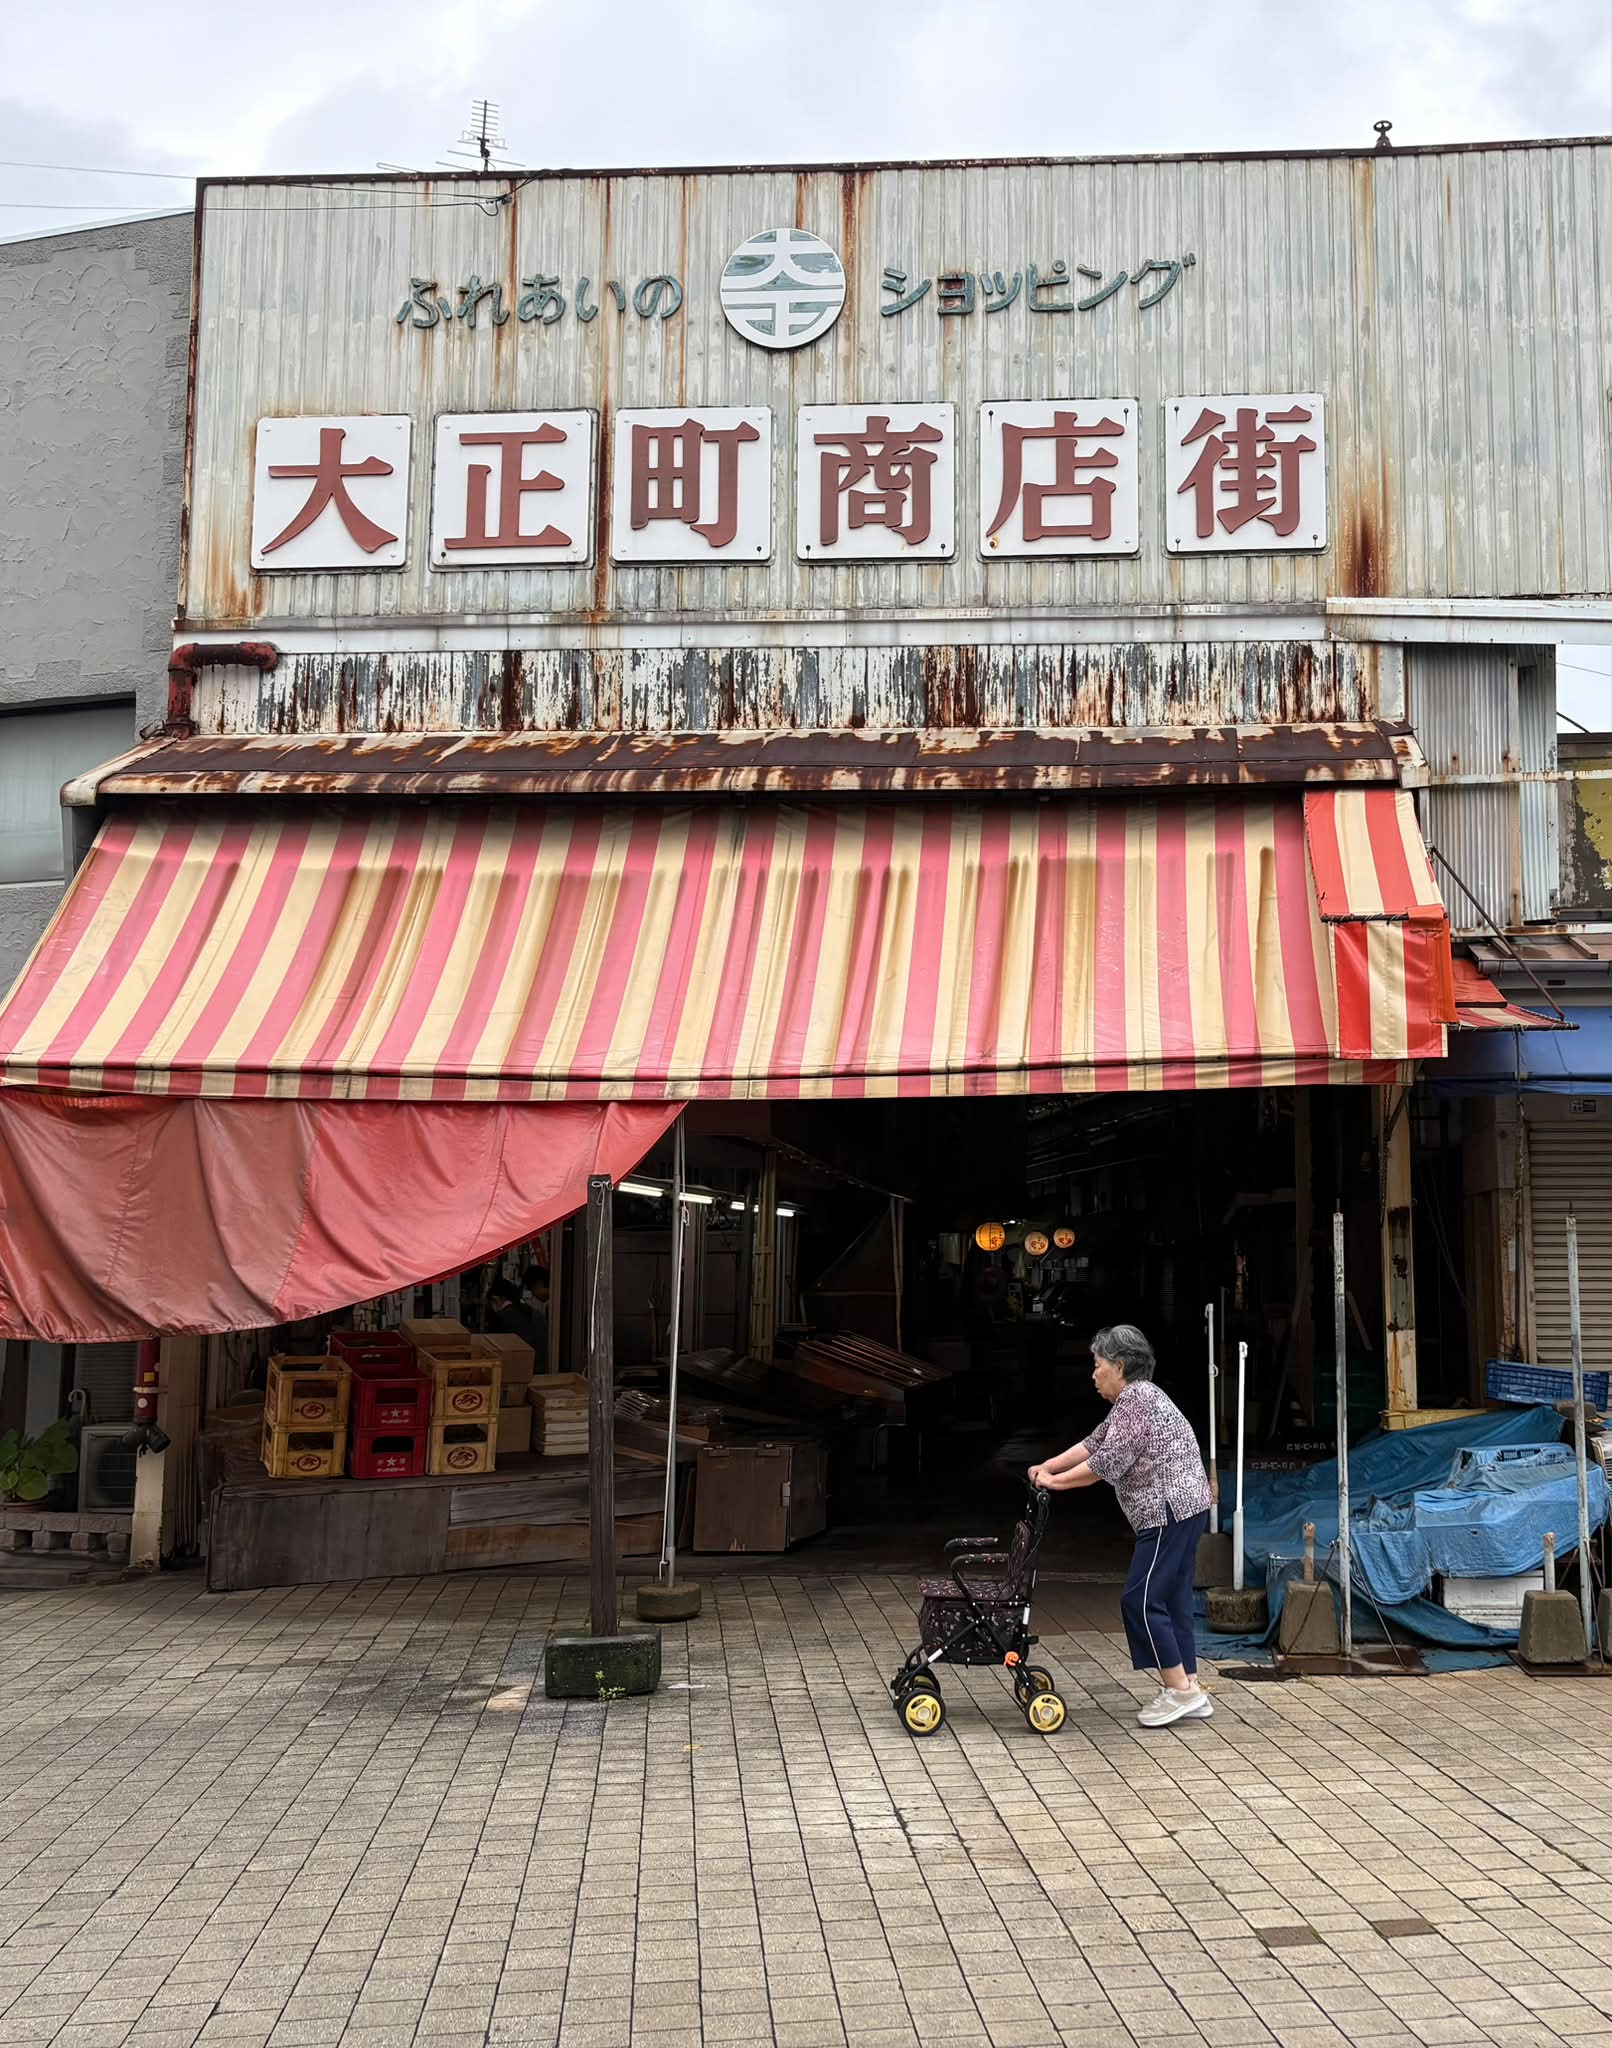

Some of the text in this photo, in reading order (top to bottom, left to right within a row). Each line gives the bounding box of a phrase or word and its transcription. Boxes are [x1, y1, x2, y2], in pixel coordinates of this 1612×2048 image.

[396, 273, 682, 329] ふれあいの
[881, 252, 1197, 317] ショッピング
[261, 405, 1316, 554] 大正町商店街
